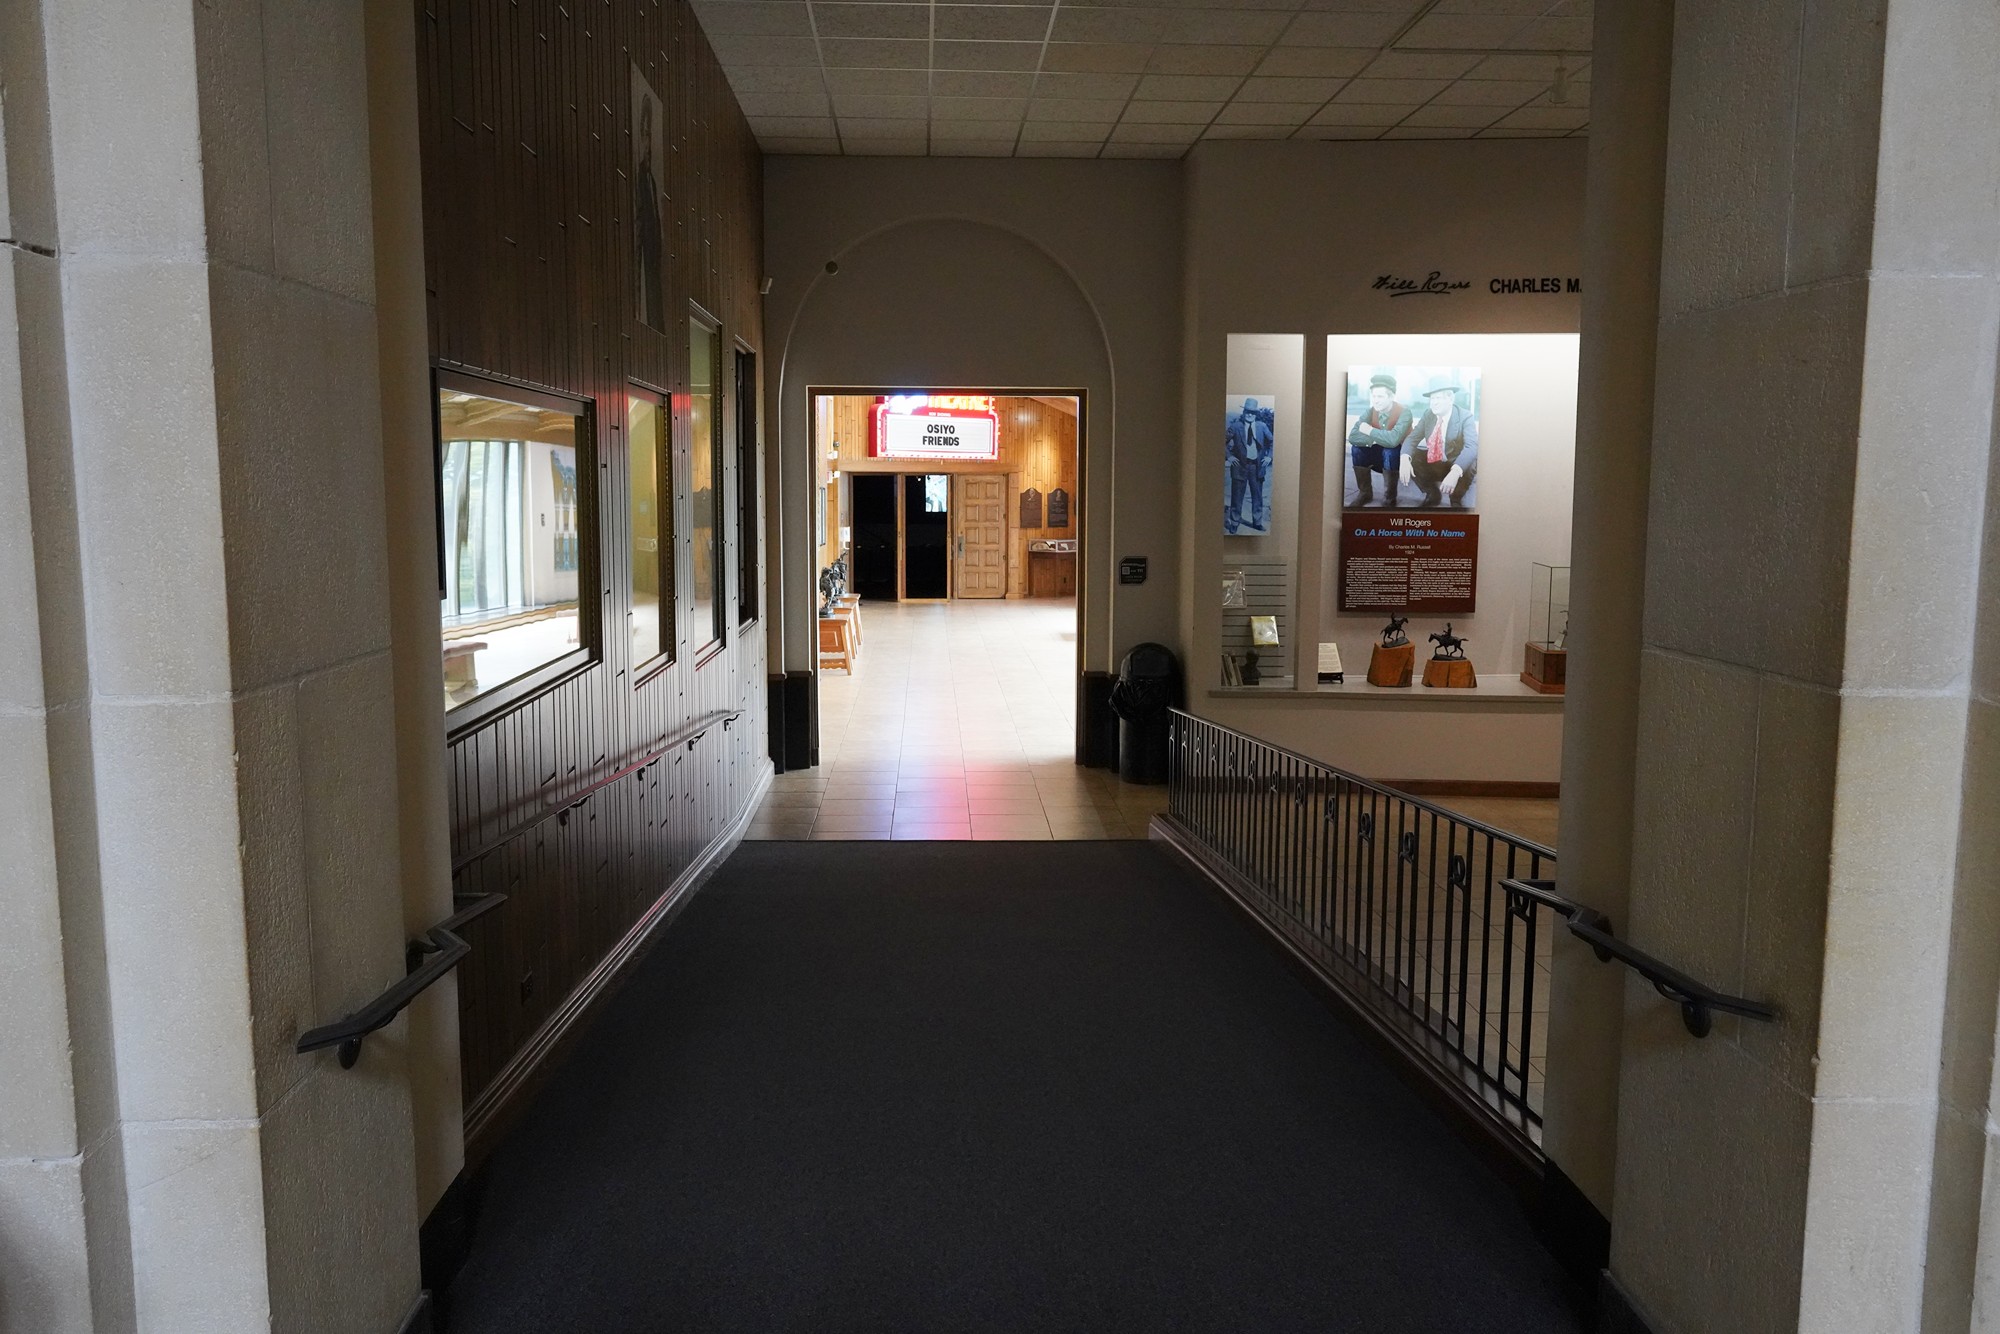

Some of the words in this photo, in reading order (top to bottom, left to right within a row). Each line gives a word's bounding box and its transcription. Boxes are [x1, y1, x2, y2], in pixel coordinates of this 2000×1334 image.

[1372, 274, 1418, 290] Will
[1421, 271, 1472, 294] Rogers
[1490, 278, 1561, 294] CHARLES
[927, 424, 956, 434] OSIYO
[922, 435, 960, 446] FRIENDS
[1390, 518, 1403, 526] Will
[1405, 518, 1432, 528] Rogers
[1354, 528, 1367, 537] On
[1378, 529, 1403, 537] Horse
[1405, 529, 1424, 537] With
[1427, 529, 1439, 537] No
[1440, 529, 1466, 537] Name
